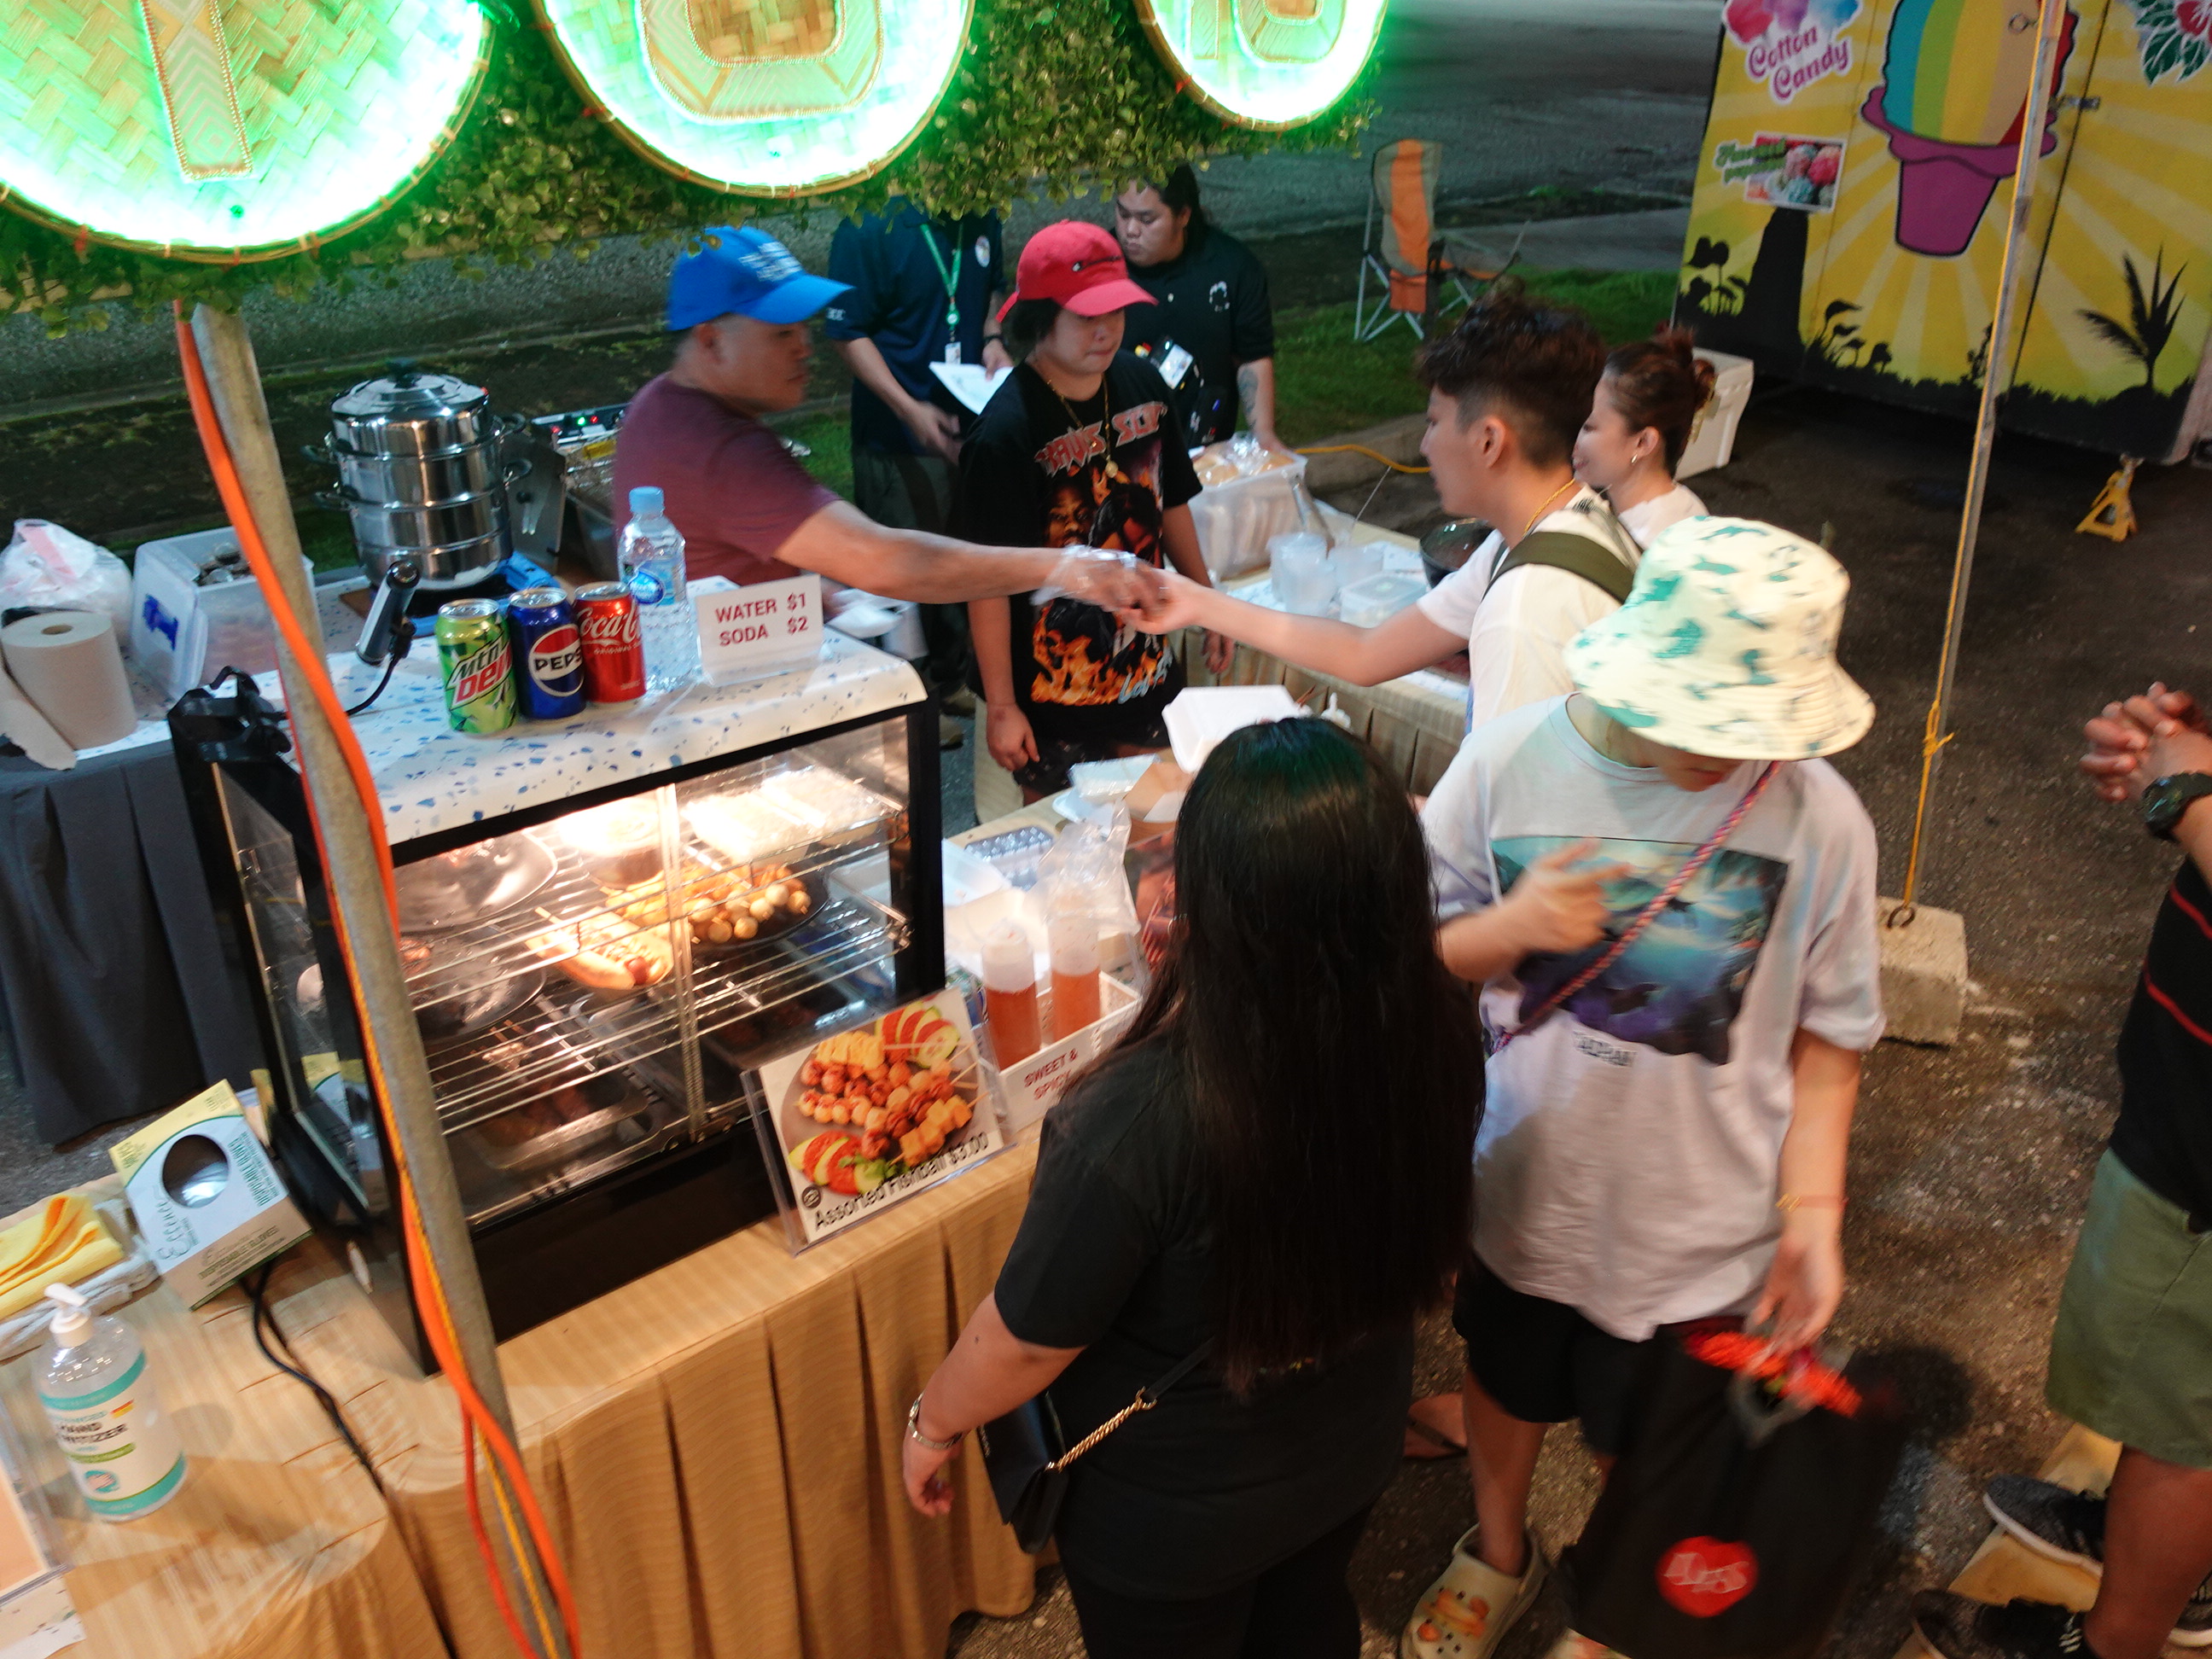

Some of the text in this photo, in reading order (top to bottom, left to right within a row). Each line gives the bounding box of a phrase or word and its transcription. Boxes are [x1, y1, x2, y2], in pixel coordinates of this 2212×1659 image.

[1749, 26, 1818, 79] Cotton
[1773, 40, 1848, 99] Candy
[715, 592, 806, 624] WATER $1
[719, 615, 809, 647] SODA $2
[534, 645, 583, 672] PEPS
[1024, 1050, 1079, 1088] SWEET &
[814, 1181, 887, 1231] Assorted
[946, 1132, 989, 1168] $3.00
